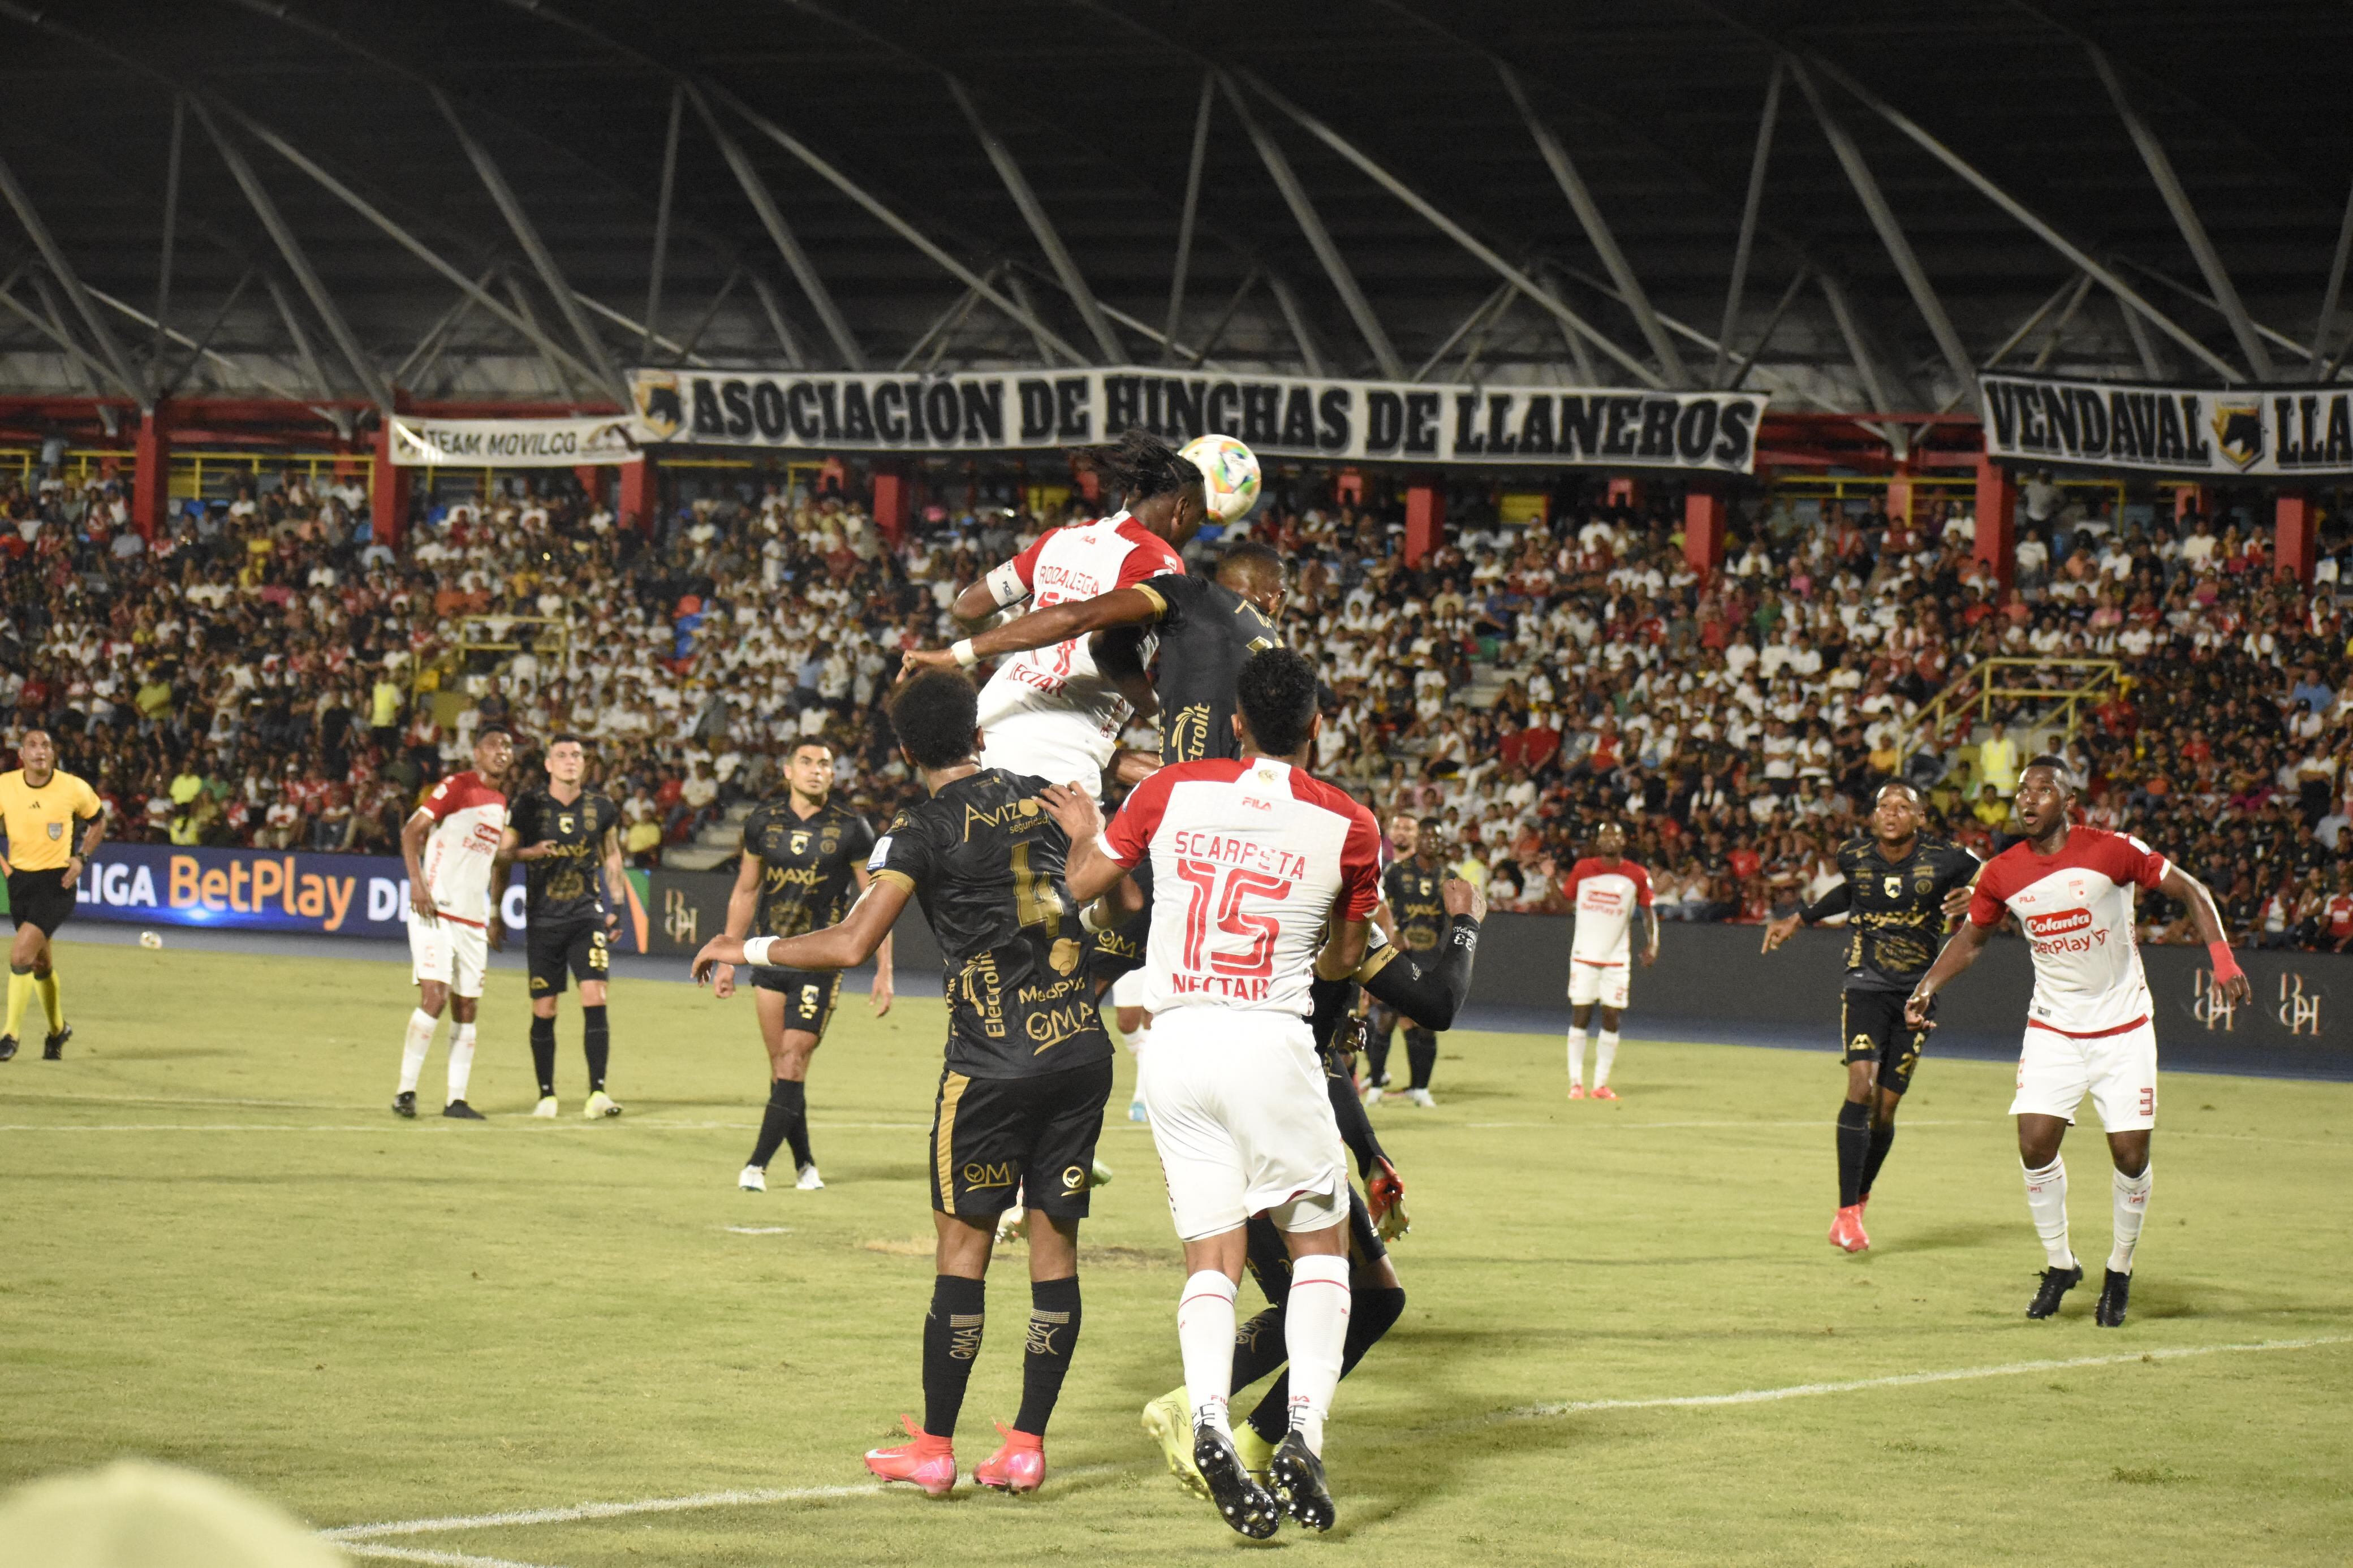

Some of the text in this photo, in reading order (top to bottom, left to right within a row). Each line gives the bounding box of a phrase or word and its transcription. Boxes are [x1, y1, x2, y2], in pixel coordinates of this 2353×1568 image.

[1021, 377, 1090, 439] DE
[1105, 376, 1352, 450] HINCHAS
[1366, 389, 1441, 452] DE
[1454, 393, 1757, 463] LLANEROS
[1984, 382, 2209, 465] VENDAVAL
[427, 430, 480, 453] TEAM
[487, 431, 577, 454] MOVILCO
[1242, 797, 1272, 811] FILA
[1009, 814, 1049, 834] seguridad
[1174, 831, 1305, 880] SCARPETA
[76, 863, 157, 907] LIGA
[170, 854, 356, 932] BetPlay
[2019, 895, 2036, 904] FILA
[1177, 858, 1292, 977] 15
[2026, 914, 2090, 933] Colanta
[975, 950, 1006, 1038] Elecrolit
[1172, 973, 1269, 1002] NECTAR
[2140, 1088, 2154, 1116] 3
